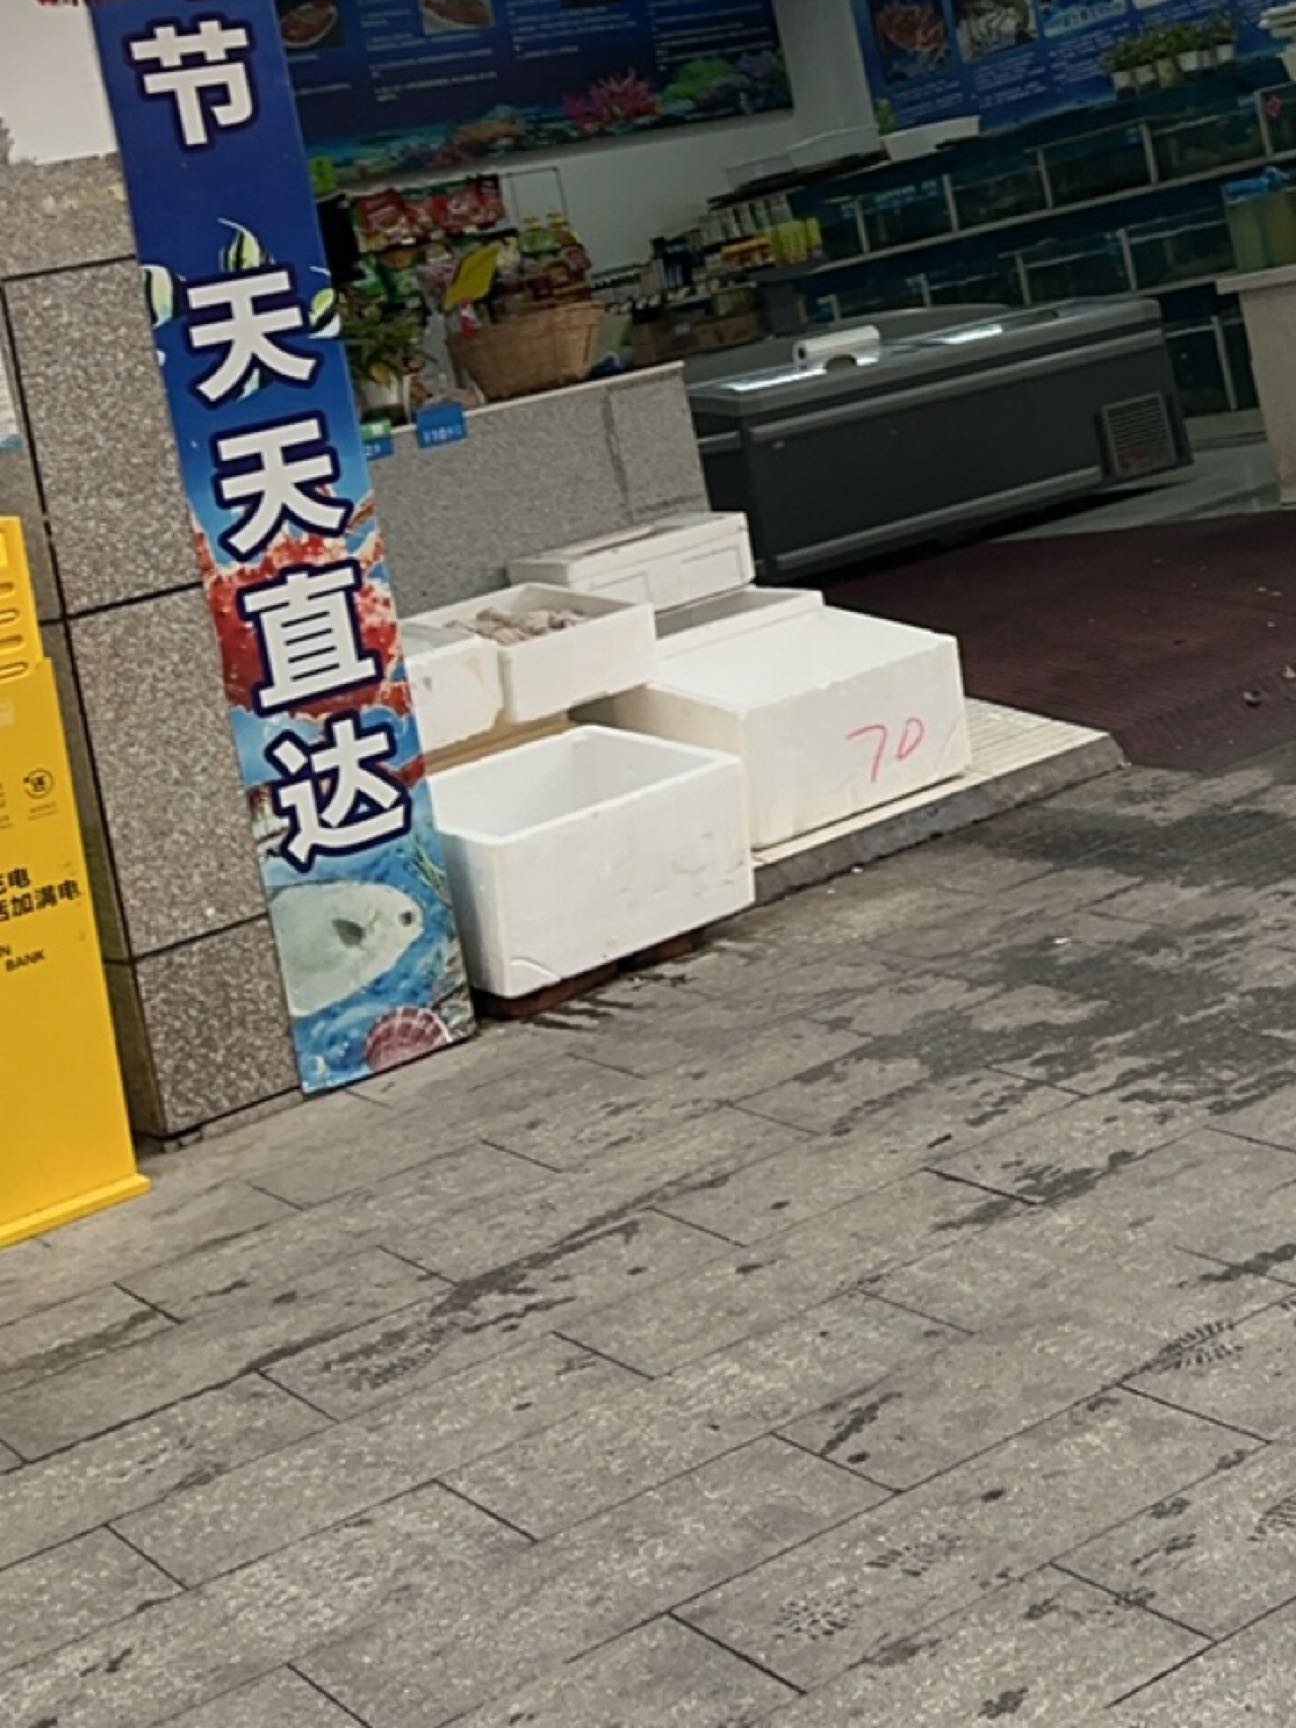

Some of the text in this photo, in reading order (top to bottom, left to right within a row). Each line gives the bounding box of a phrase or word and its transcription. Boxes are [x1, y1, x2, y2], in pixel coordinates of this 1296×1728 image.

[187, 268, 408, 865] 天天直达
[845, 717, 925, 784] 70
